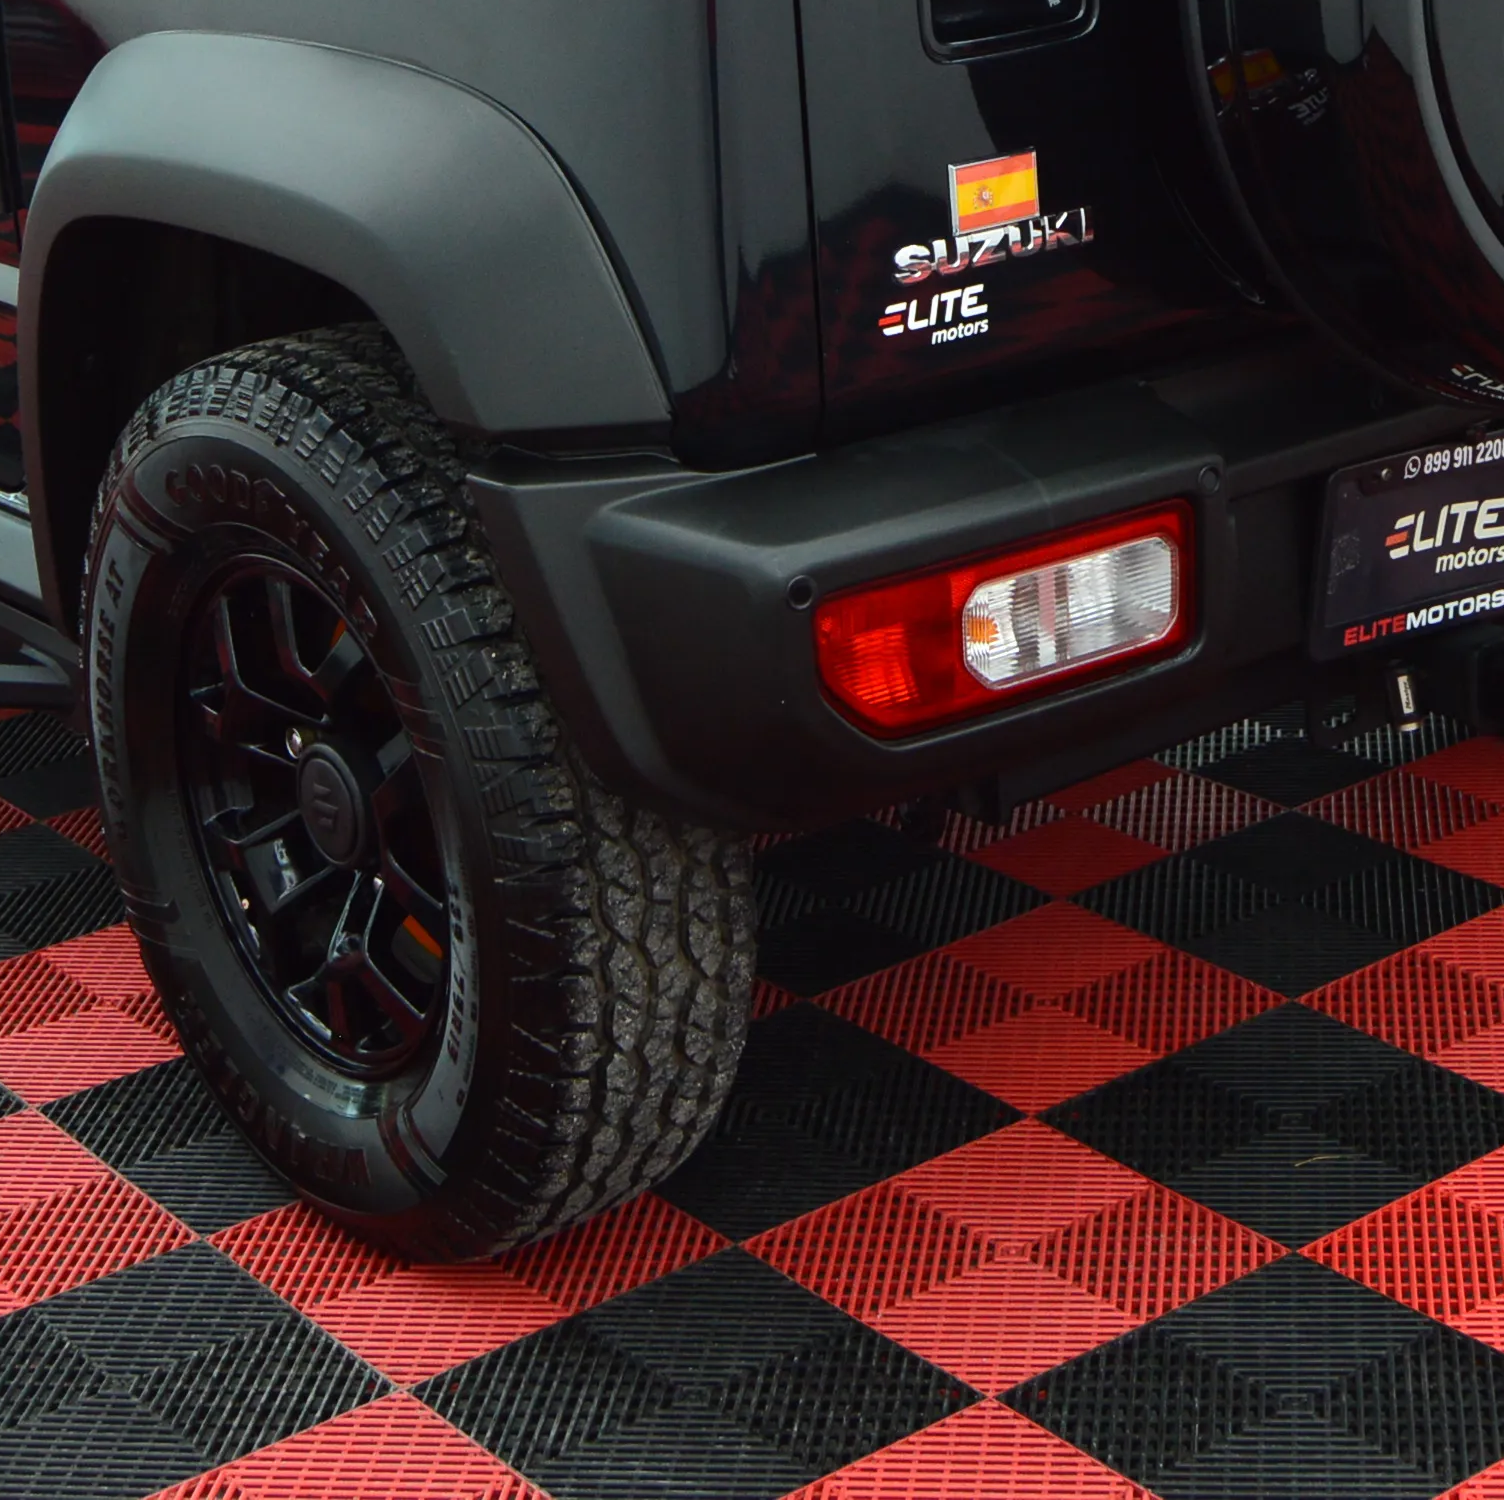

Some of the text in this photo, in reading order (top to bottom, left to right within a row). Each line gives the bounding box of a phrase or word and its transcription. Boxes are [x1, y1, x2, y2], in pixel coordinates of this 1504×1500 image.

[893, 206, 1094, 284] SUZUKI
[878, 284, 988, 337] ELITE
[931, 318, 989, 345] motors
[1424, 450, 1451, 474] 899
[1453, 446, 1473, 469] 911
